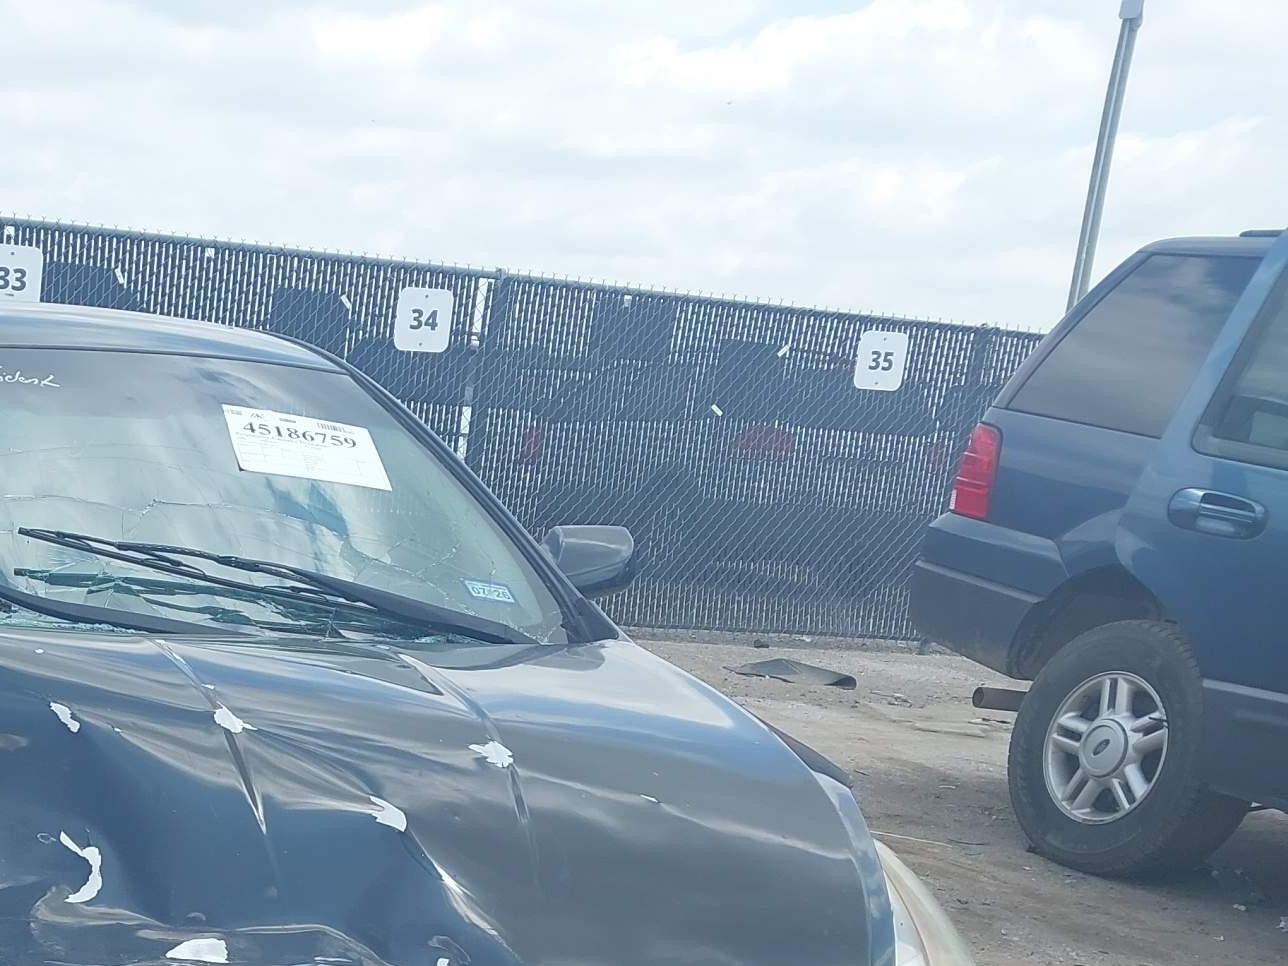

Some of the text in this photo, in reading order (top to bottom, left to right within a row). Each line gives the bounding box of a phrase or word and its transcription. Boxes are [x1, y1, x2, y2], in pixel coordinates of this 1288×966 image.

[409, 308, 438, 331] 34
[868, 350, 894, 372] 35
[243, 421, 357, 449] 45186759
